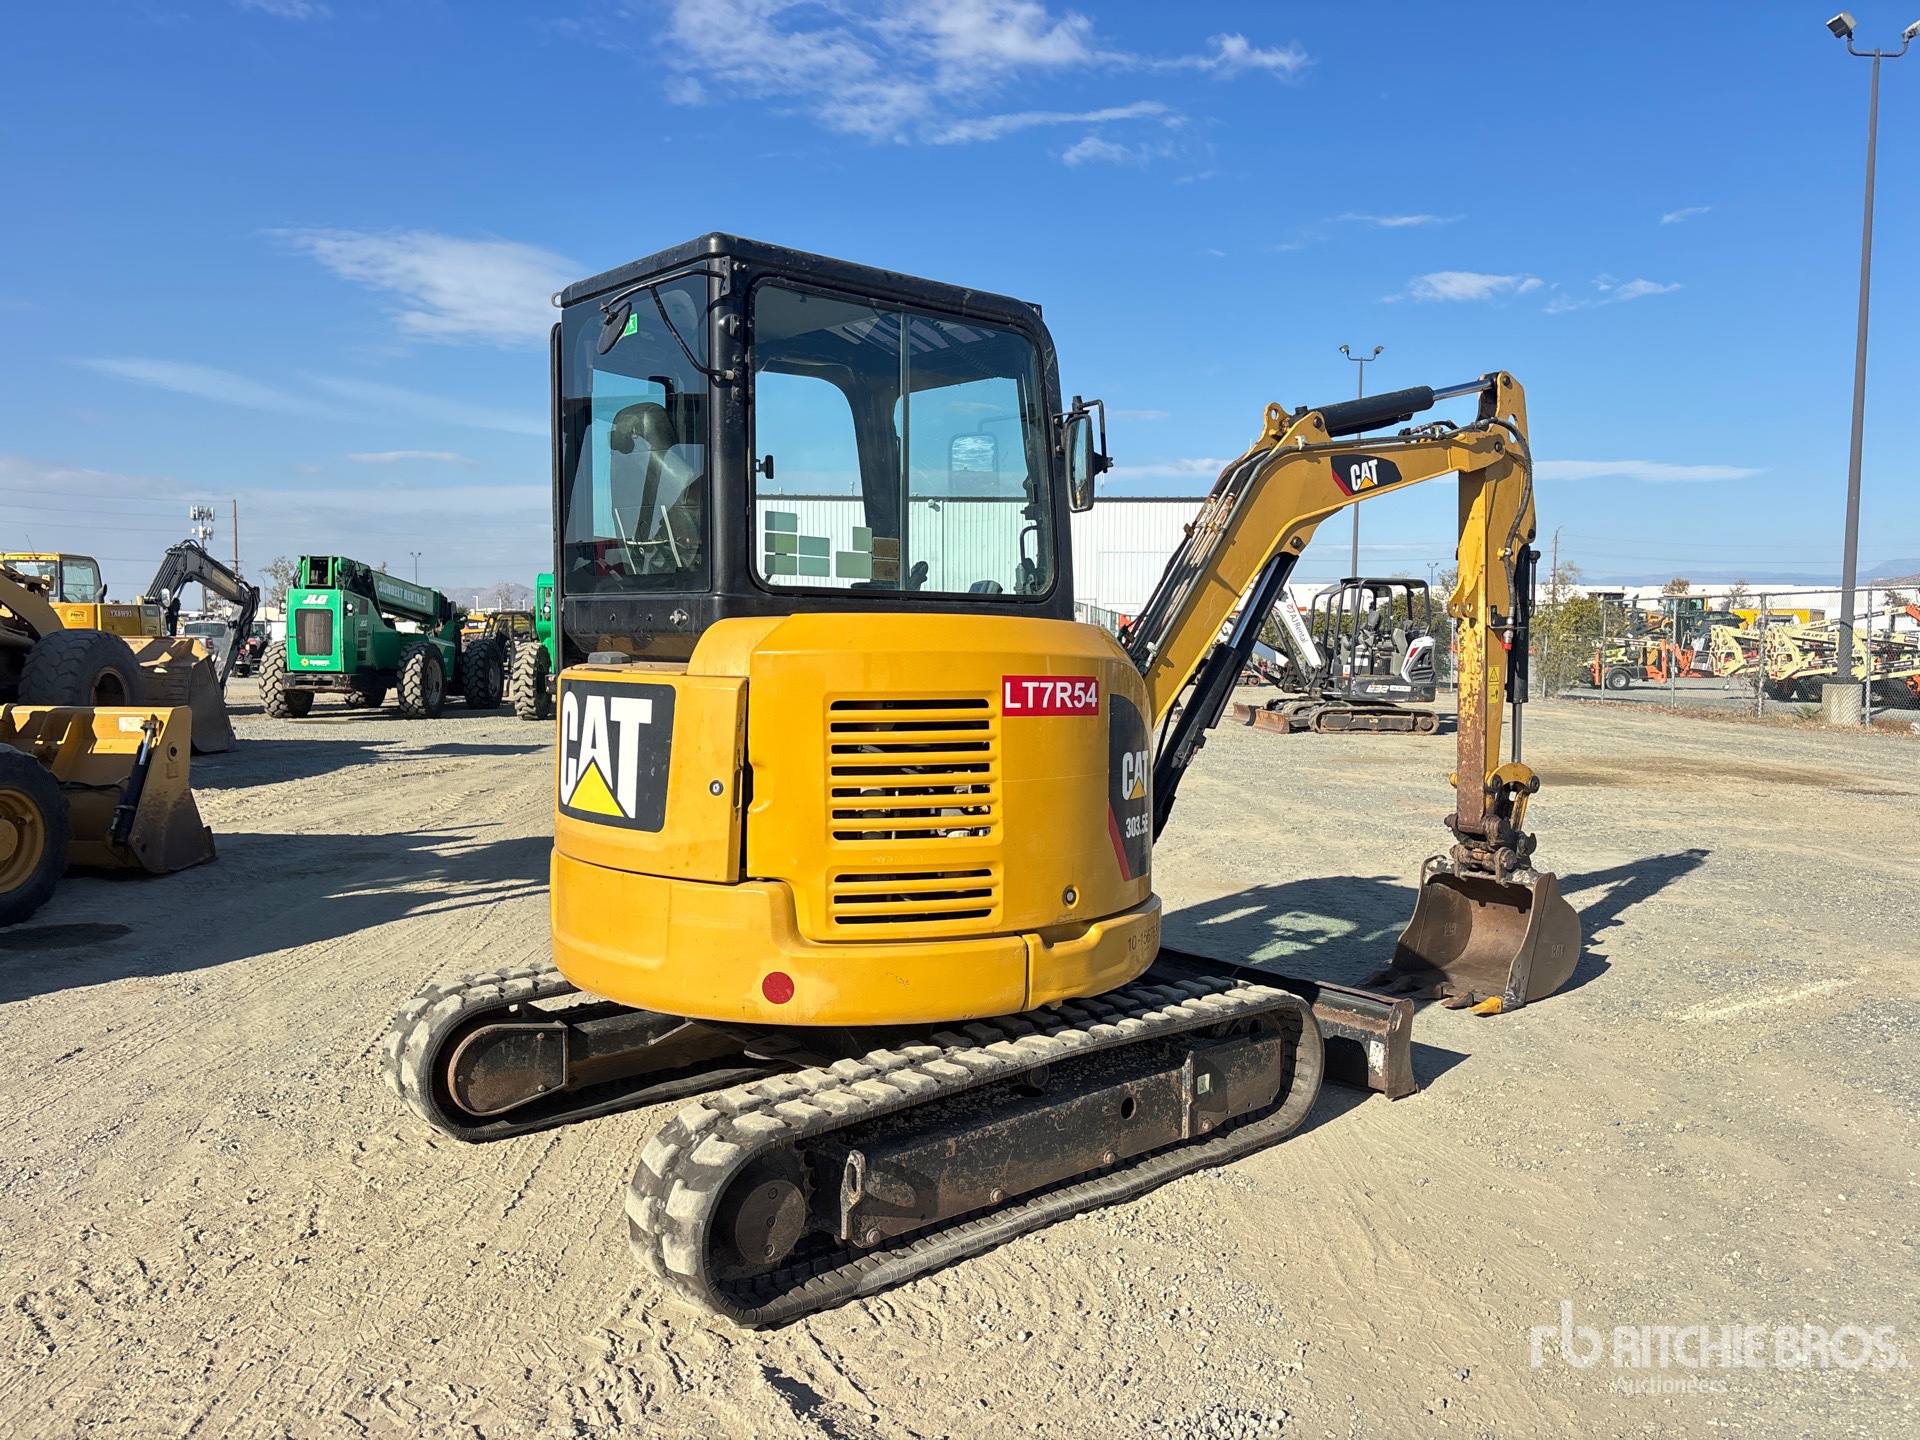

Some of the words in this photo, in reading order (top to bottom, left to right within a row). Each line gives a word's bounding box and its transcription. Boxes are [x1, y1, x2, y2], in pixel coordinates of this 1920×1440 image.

[1350, 459, 1378, 491] CAT
[302, 595, 329, 605] JLG
[1293, 621, 1308, 643] Rental
[1005, 682, 1098, 708] LT7R54
[560, 691, 653, 819] CAT
[1122, 750, 1149, 800] CAT
[1125, 812, 1149, 839] 303.5E
